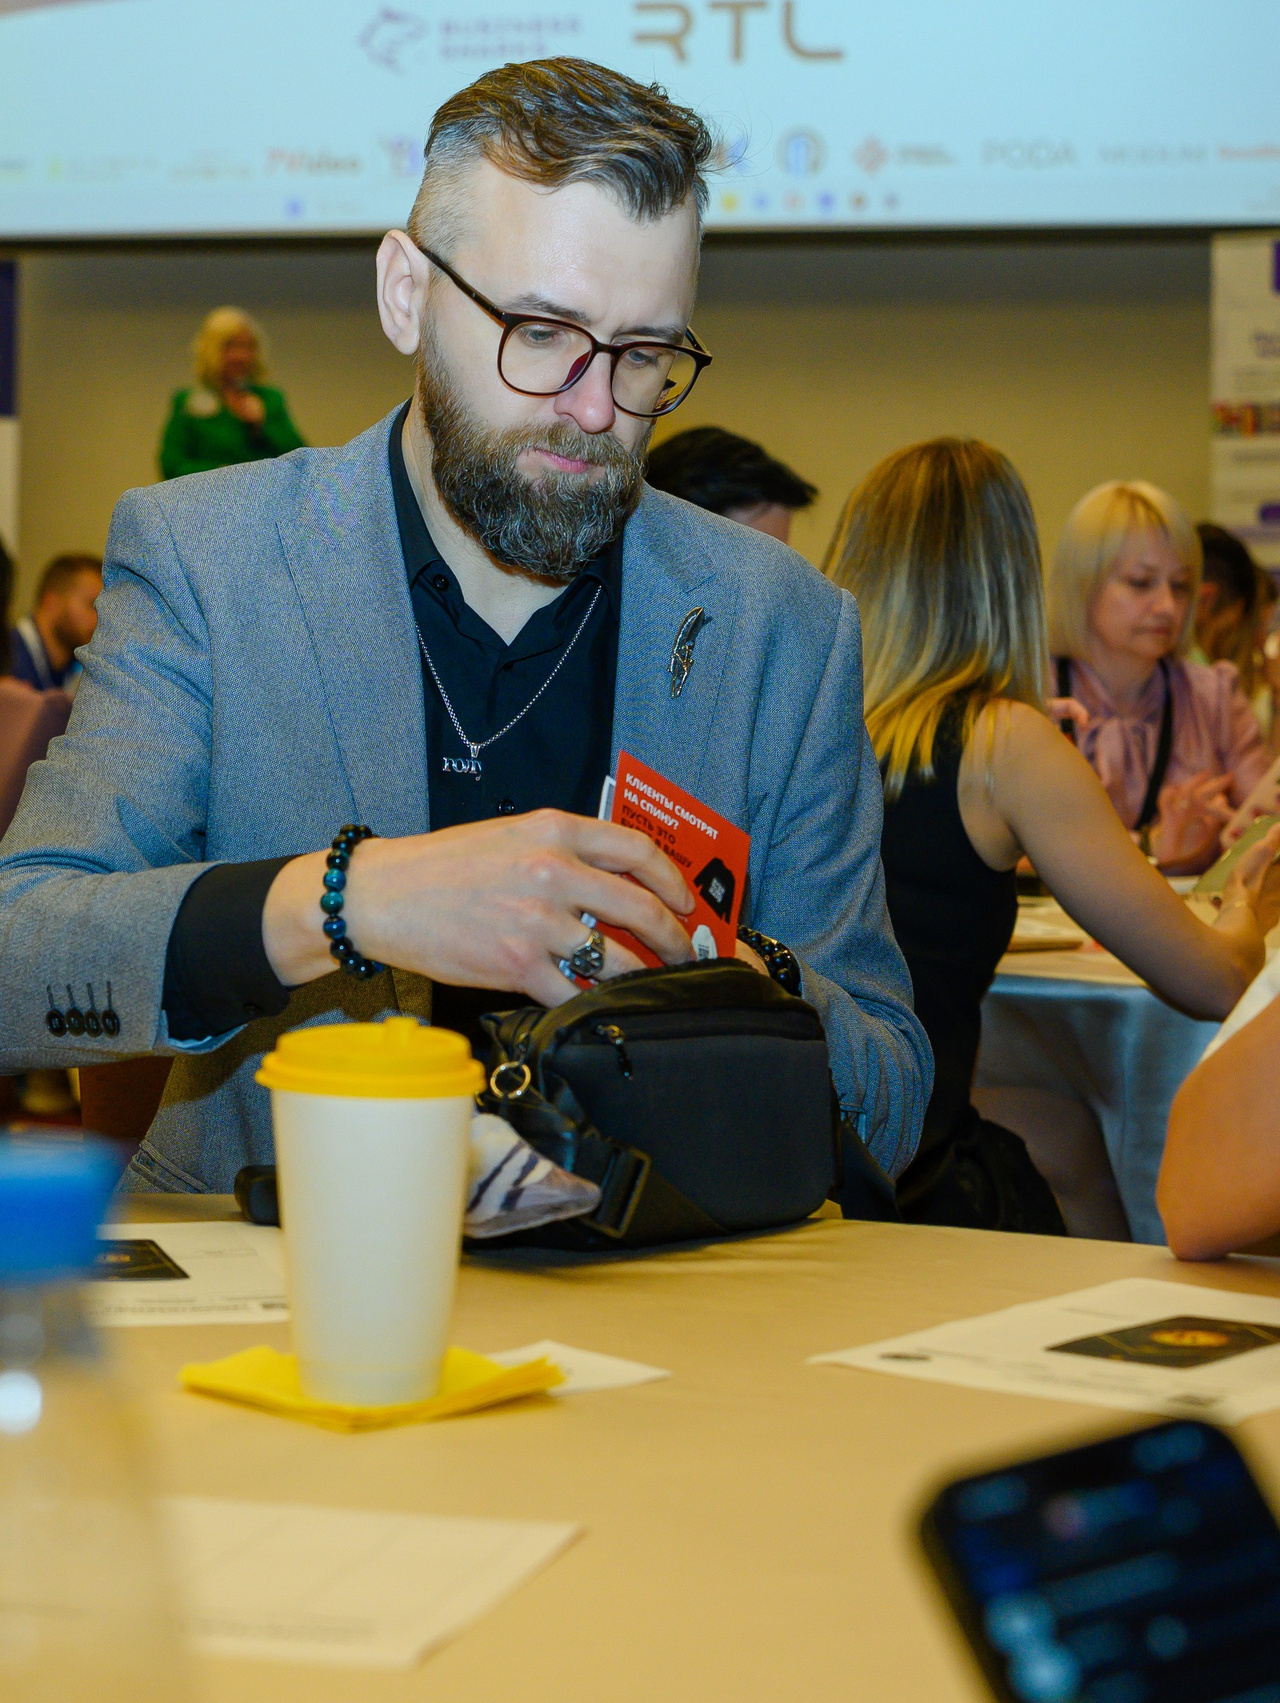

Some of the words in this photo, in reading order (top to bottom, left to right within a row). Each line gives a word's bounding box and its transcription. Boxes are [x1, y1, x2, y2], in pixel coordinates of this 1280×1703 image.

[634, 0, 843, 62] RTL
[622, 805, 654, 831] ПУСТЬ
[657, 826, 677, 845] ЭТО
[624, 788, 639, 806] НА
[640, 799, 680, 831] СПИНУ?
[626, 773, 674, 811] КЛИЕНТЫ
[675, 805, 719, 840] СМОТРЯТ
